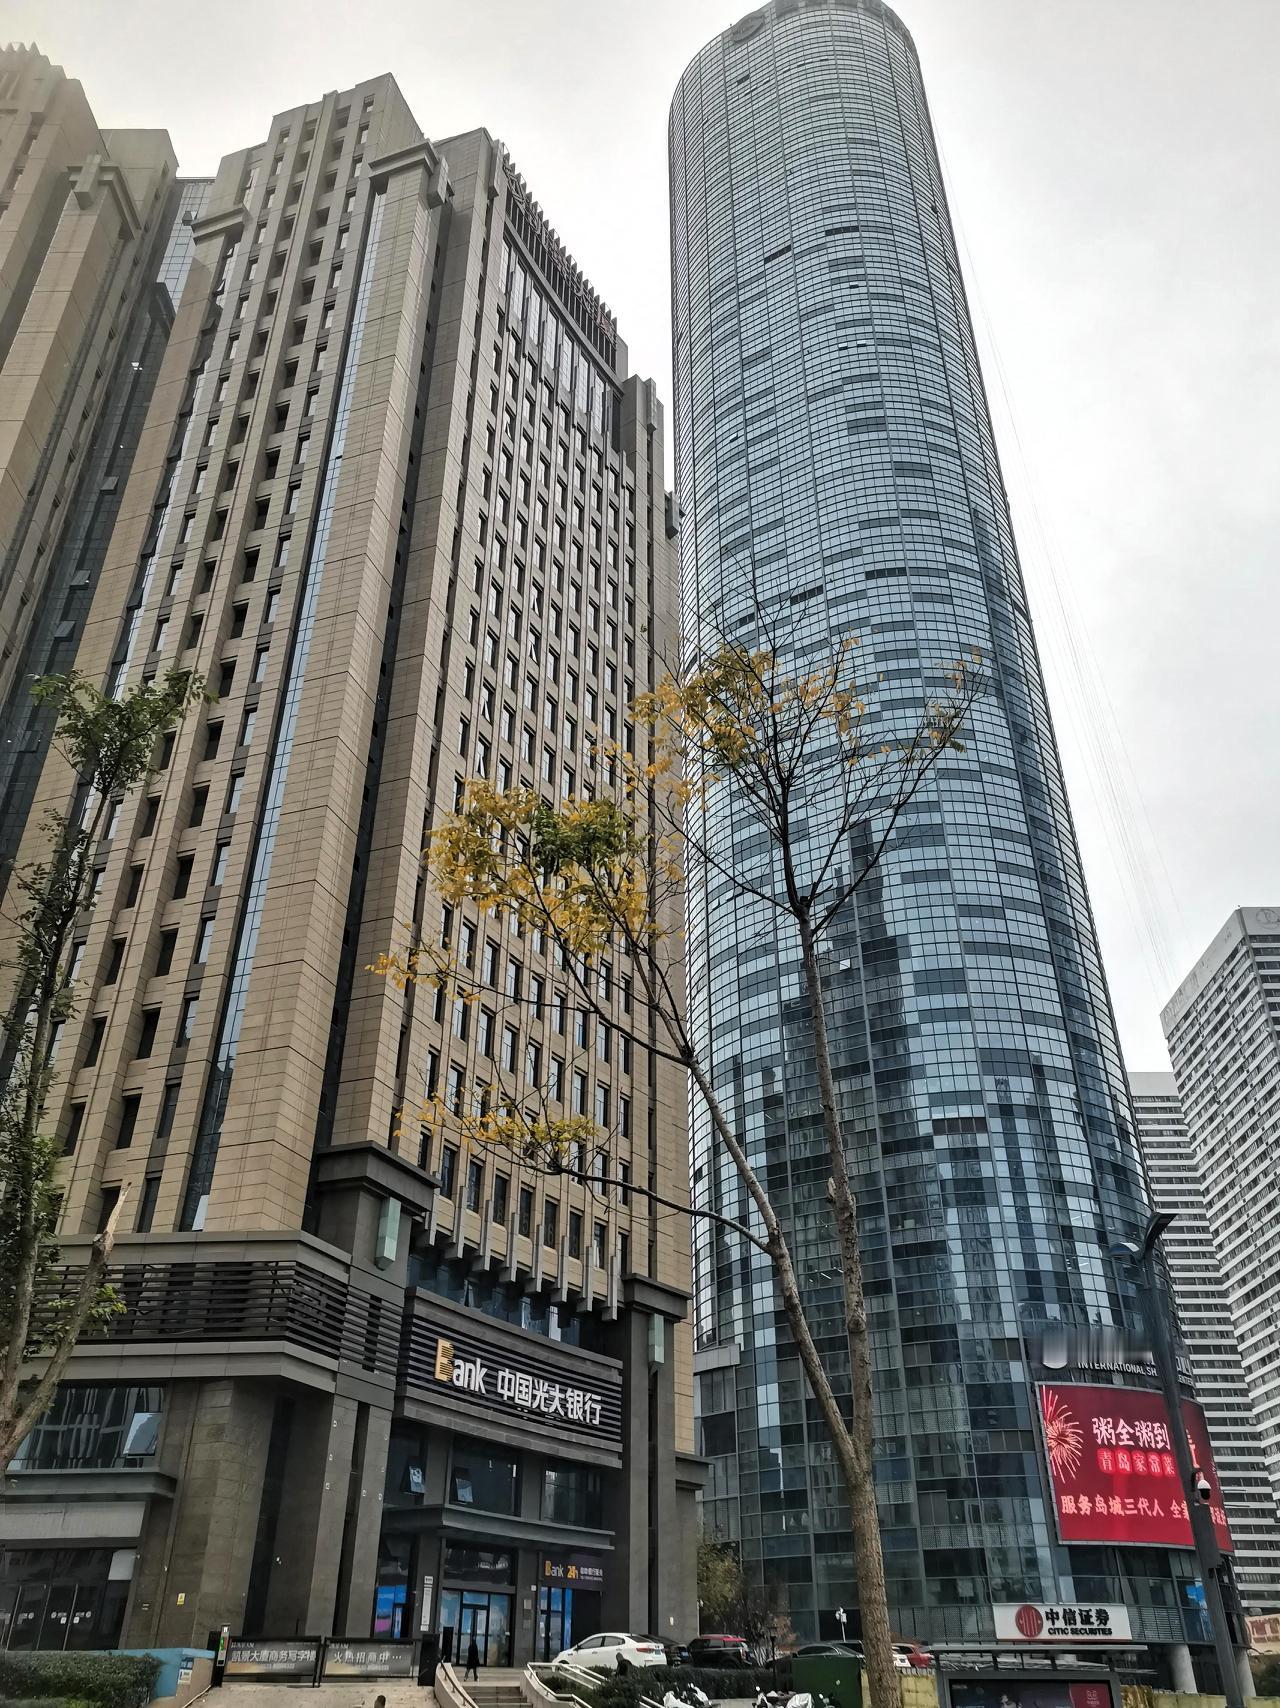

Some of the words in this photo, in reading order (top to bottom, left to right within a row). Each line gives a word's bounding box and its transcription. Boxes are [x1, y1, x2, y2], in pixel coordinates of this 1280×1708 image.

[434, 1338, 488, 1395] Bank
[497, 1368, 602, 1426] 中国光大银行
[1091, 1416, 1171, 1450] 粥全粥到
[1101, 1450, 1176, 1475] 青岛家常菜
[1060, 1494, 1165, 1518] 服务岛城三代人
[1045, 1607, 1110, 1627] 中信证券
[1047, 1627, 1069, 1636] CITIC
[1070, 1627, 1113, 1636] SECURITIES
